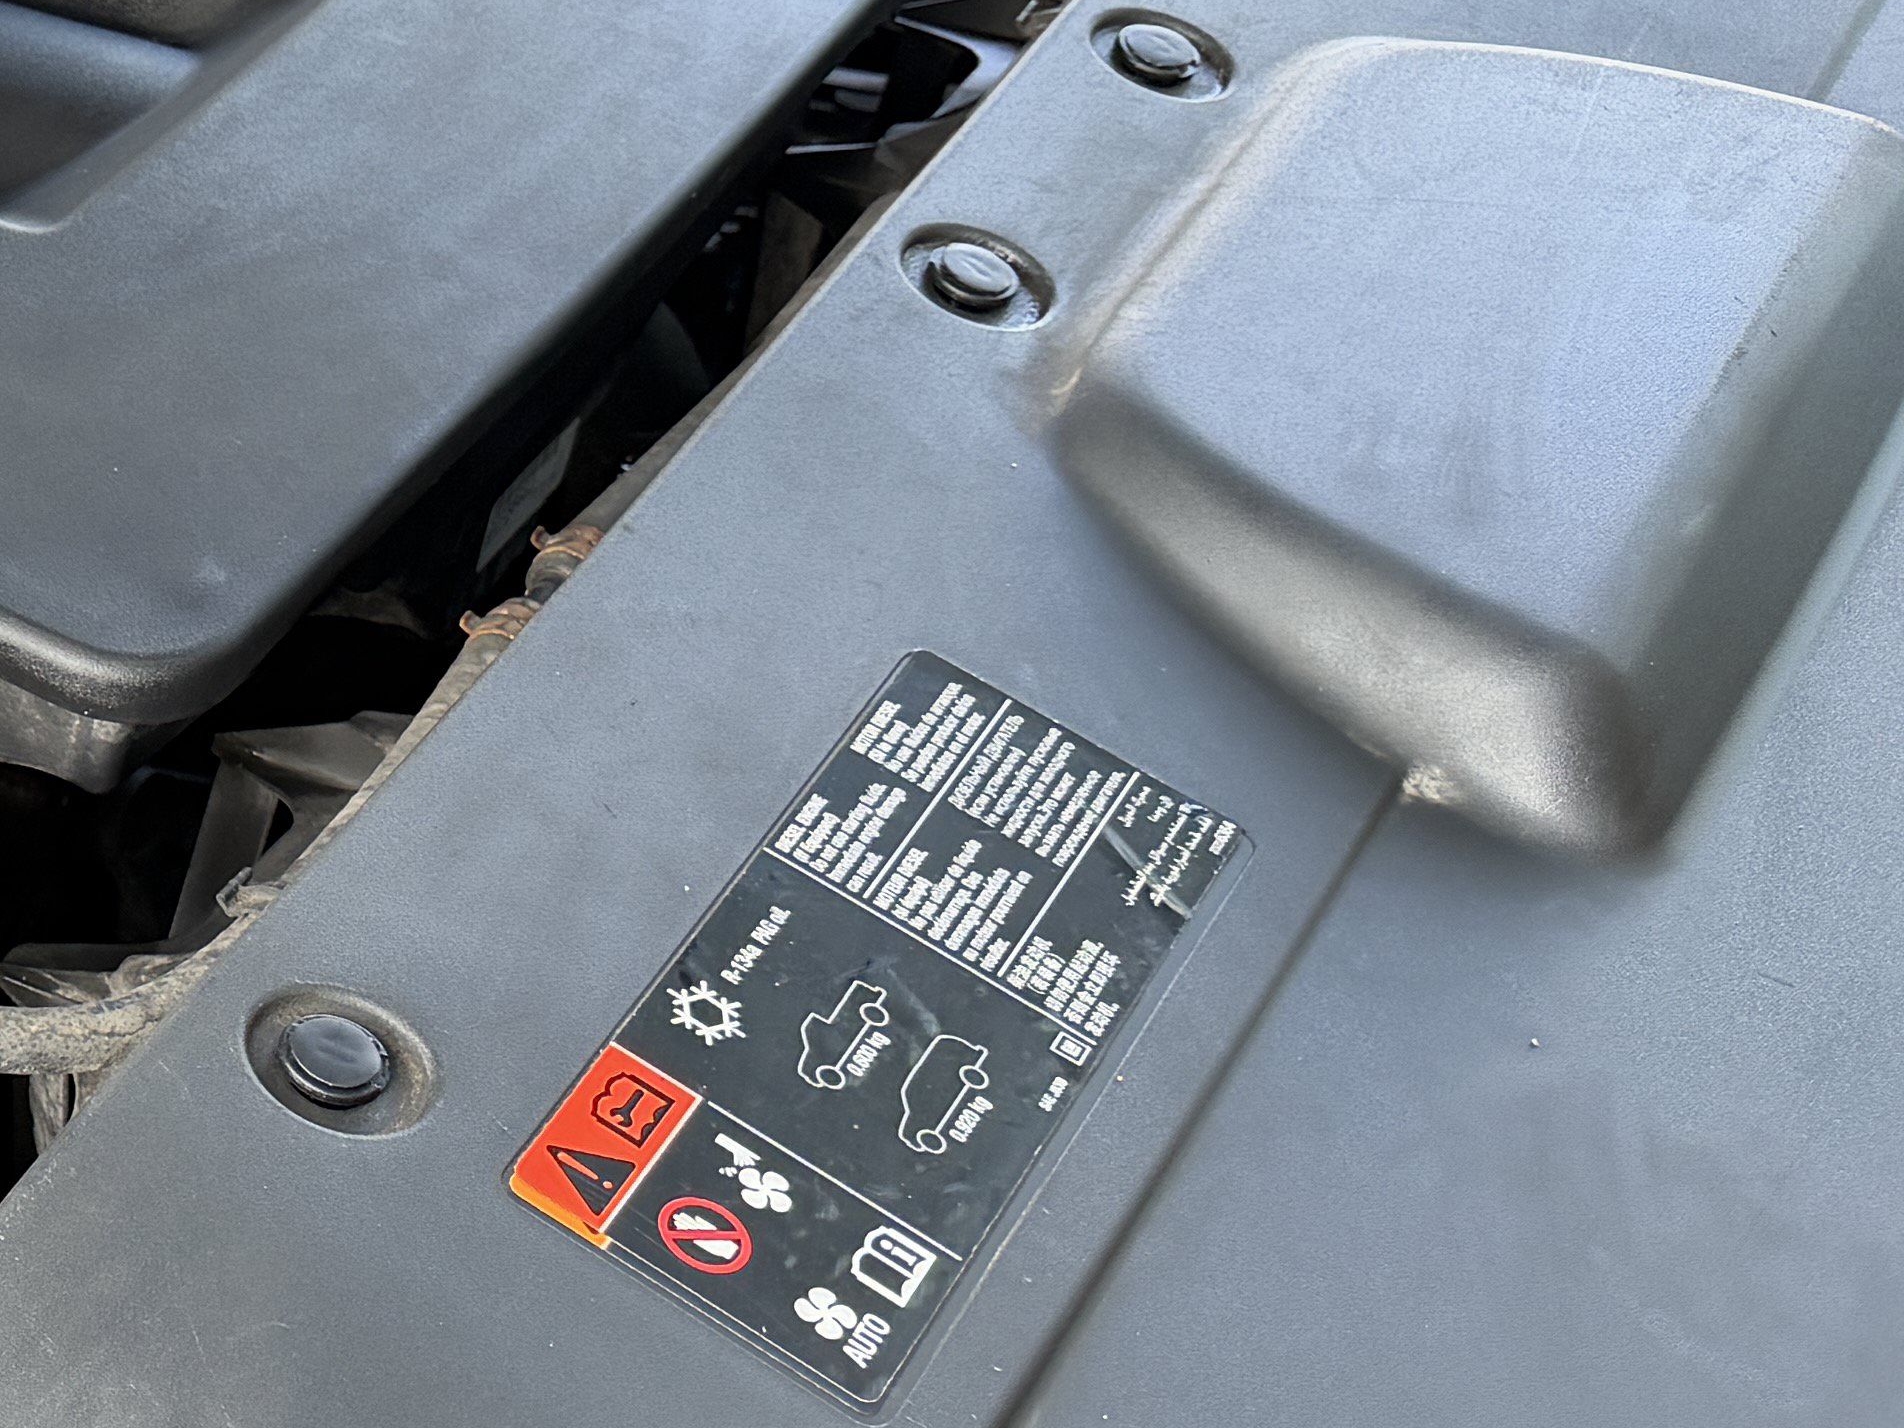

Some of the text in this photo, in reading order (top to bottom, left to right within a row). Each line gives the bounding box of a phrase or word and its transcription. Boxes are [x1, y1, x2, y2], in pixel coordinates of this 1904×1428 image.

[719, 943, 763, 985] R-134a
[750, 918, 780, 945] PAG
[863, 1030, 891, 1049] kg
[948, 1095, 994, 1143] 0.920 kg
[842, 1312, 890, 1369] AUTO
